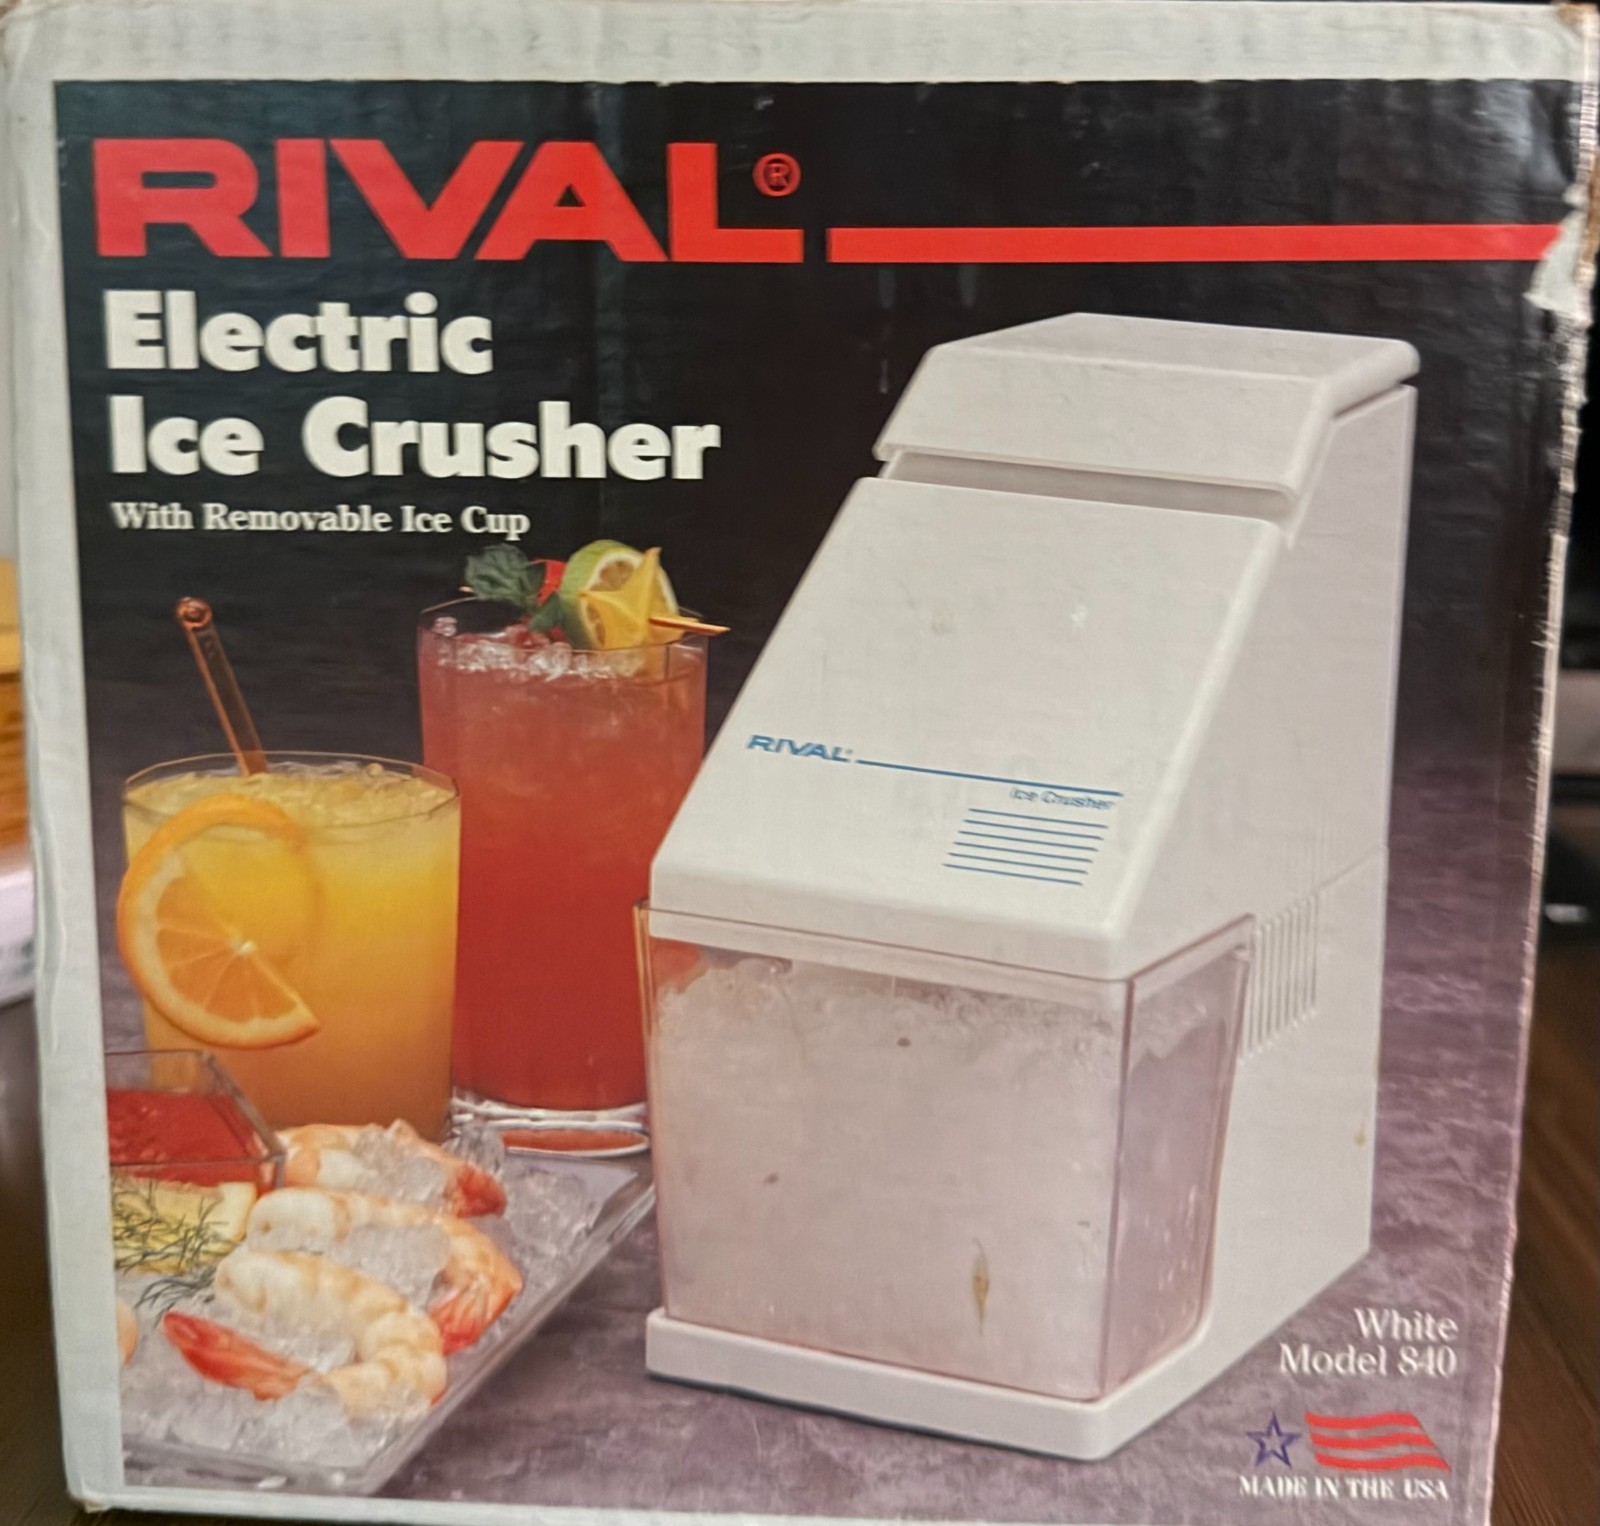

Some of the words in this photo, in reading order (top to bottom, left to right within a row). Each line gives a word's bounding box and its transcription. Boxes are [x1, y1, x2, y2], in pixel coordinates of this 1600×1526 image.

[103, 289, 494, 375] Electric
[108, 395, 265, 475] Ice
[303, 396, 721, 480] Crusher
[111, 502, 194, 530] With
[202, 503, 393, 532] Removable
[400, 505, 453, 533] Ice
[460, 506, 531, 541] Cup
[1354, 1307, 1459, 1342] White
[1279, 1342, 1388, 1377] Model
[1397, 1345, 1457, 1379] 840
[1239, 1474, 1307, 1498] MADE
[1314, 1475, 1340, 1499] IN
[1344, 1476, 1395, 1500] THE
[1403, 1477, 1451, 1501] USA
